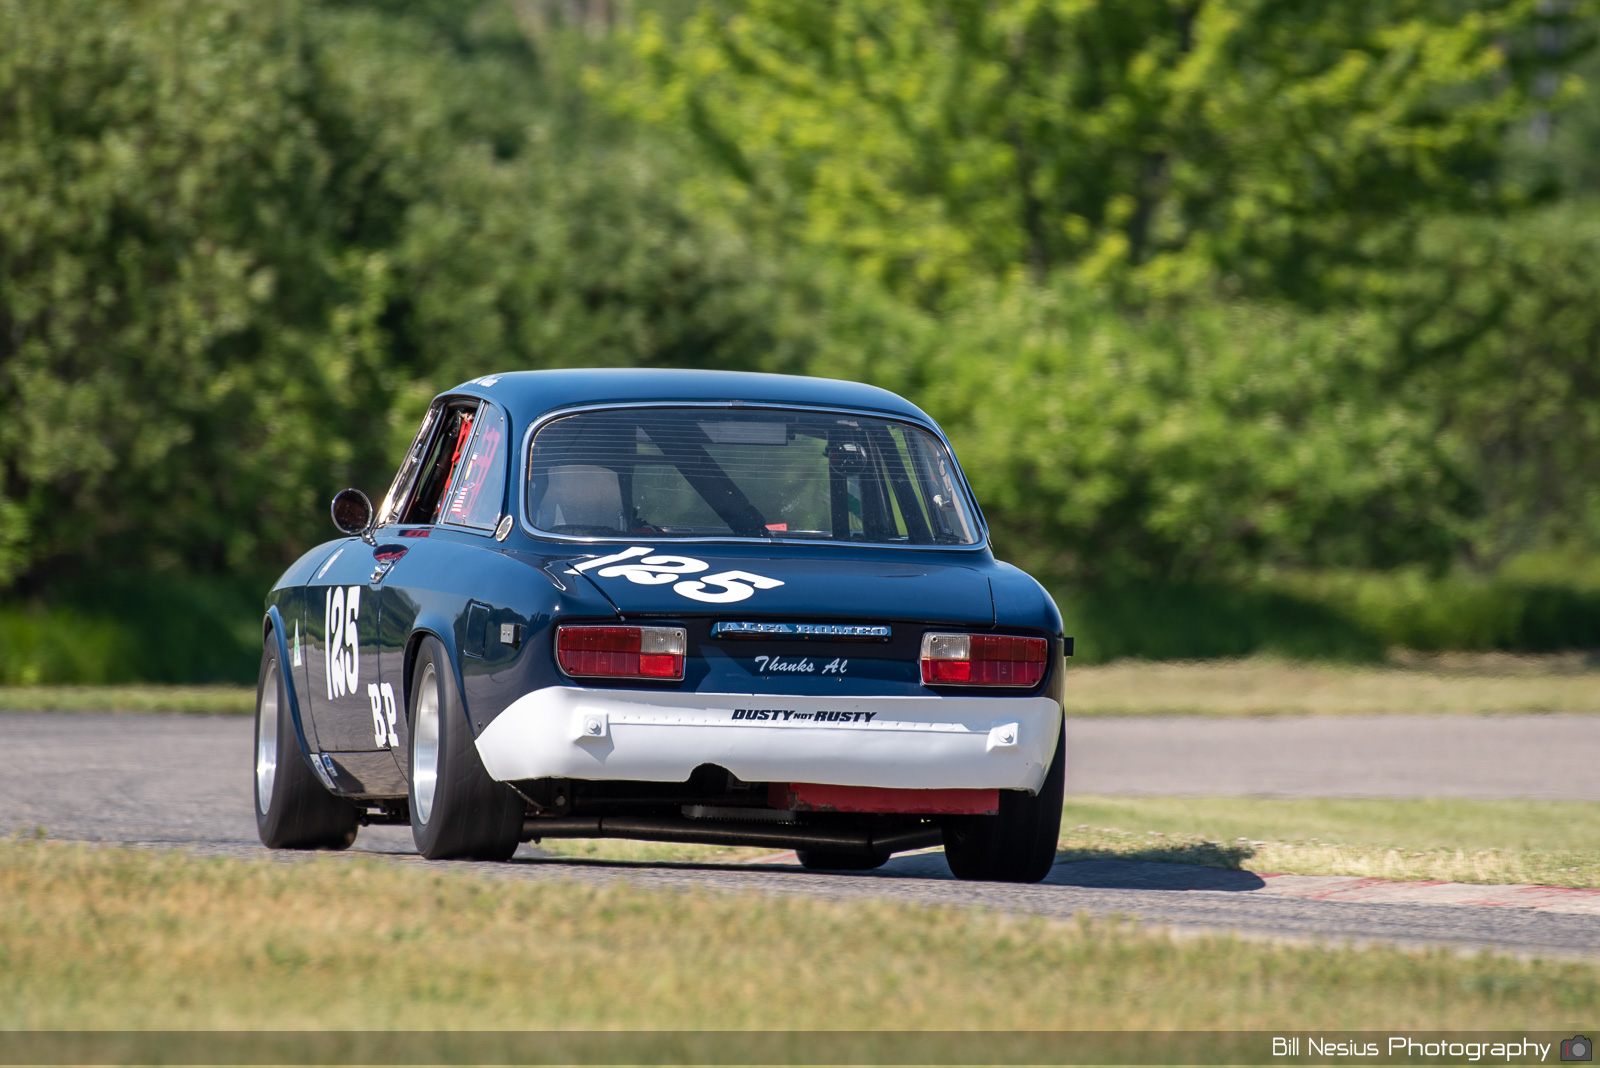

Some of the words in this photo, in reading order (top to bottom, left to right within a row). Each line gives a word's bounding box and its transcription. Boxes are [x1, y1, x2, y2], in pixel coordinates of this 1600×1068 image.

[564, 546, 785, 603] 125
[325, 585, 361, 700] 125
[720, 622, 793, 633] ALFA
[796, 625, 889, 636] ROMEO
[754, 655, 815, 673] Thanks
[821, 657, 848, 674] Al
[368, 682, 399, 748] BP
[732, 709, 795, 721] DUSTY
[793, 712, 815, 720] NOT
[814, 711, 877, 723] RUSTY
